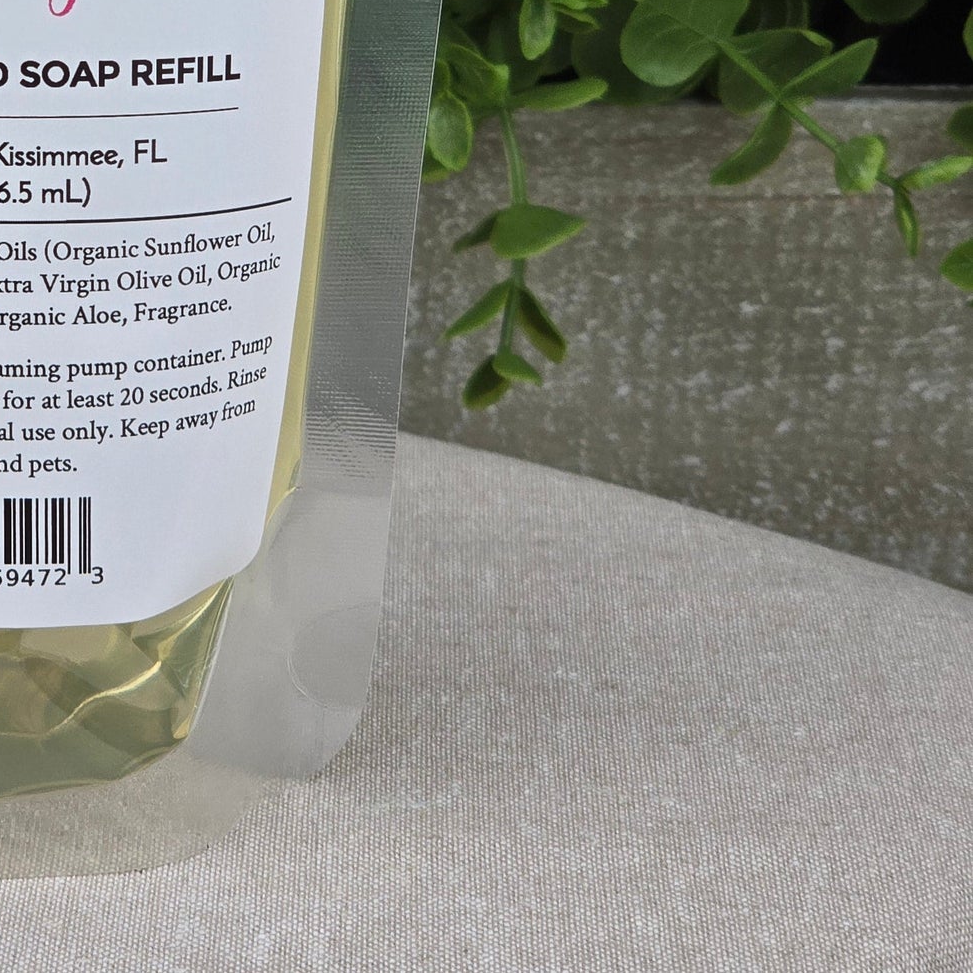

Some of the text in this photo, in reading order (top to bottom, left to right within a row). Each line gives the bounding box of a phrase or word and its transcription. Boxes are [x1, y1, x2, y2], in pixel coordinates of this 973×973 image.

[19, 59, 121, 89] SOAP
[131, 53, 241, 87] REFILL
[134, 138, 168, 165] FL
[41, 176, 92, 209] mL)
[44, 238, 140, 266] (Organic
[143, 233, 243, 258] Sunflower
[246, 221, 276, 245] Oil,
[39, 273, 111, 299] Virgin
[116, 269, 173, 291] Olive
[177, 263, 213, 287] Oil,
[217, 252, 281, 283] Organic
[71, 304, 128, 328] Aloe,
[133, 298, 233, 325] Fragrance.
[65, 361, 128, 383] pump
[133, 348, 226, 374] container.
[229, 335, 273, 360] Pump
[2, 389, 36, 410] for
[41, 393, 62, 410] at
[66, 388, 115, 409] least
[119, 386, 145, 407] 20
[149, 375, 223, 404] seconds.
[226, 366, 267, 391] Rinse
[21, 427, 56, 442] use
[61, 419, 114, 445] only.
[120, 417, 170, 440] Keep
[175, 409, 219, 431] away
[220, 399, 256, 422] from
[27, 456, 78, 479] pets.
[91, 566, 104, 585] 3
